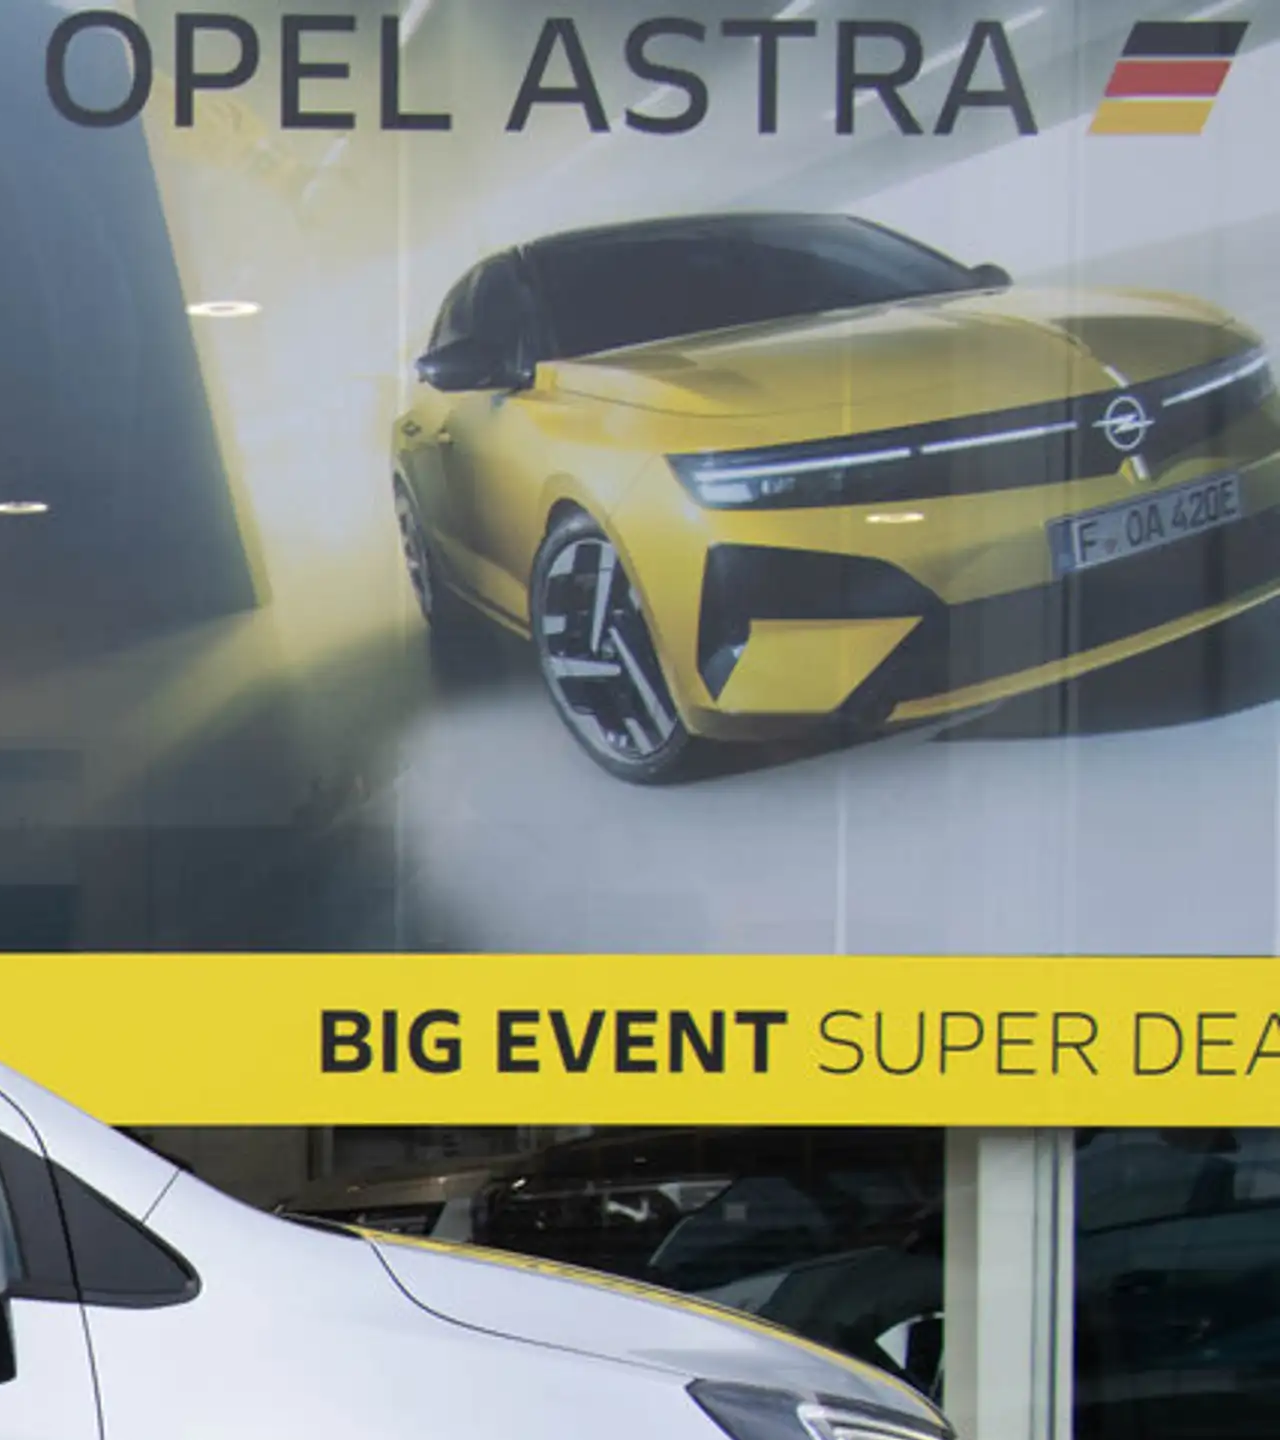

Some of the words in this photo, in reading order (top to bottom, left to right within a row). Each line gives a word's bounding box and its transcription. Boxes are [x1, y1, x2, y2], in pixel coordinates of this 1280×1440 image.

[45, 10, 451, 131] OPEL
[506, 16, 1038, 135] ASTRA
[1078, 521, 1097, 563] F
[1171, 480, 1238, 531] 420E
[320, 1008, 463, 1075] BIG
[496, 1008, 788, 1075] EVENT
[817, 1008, 1100, 1077] SUPER
